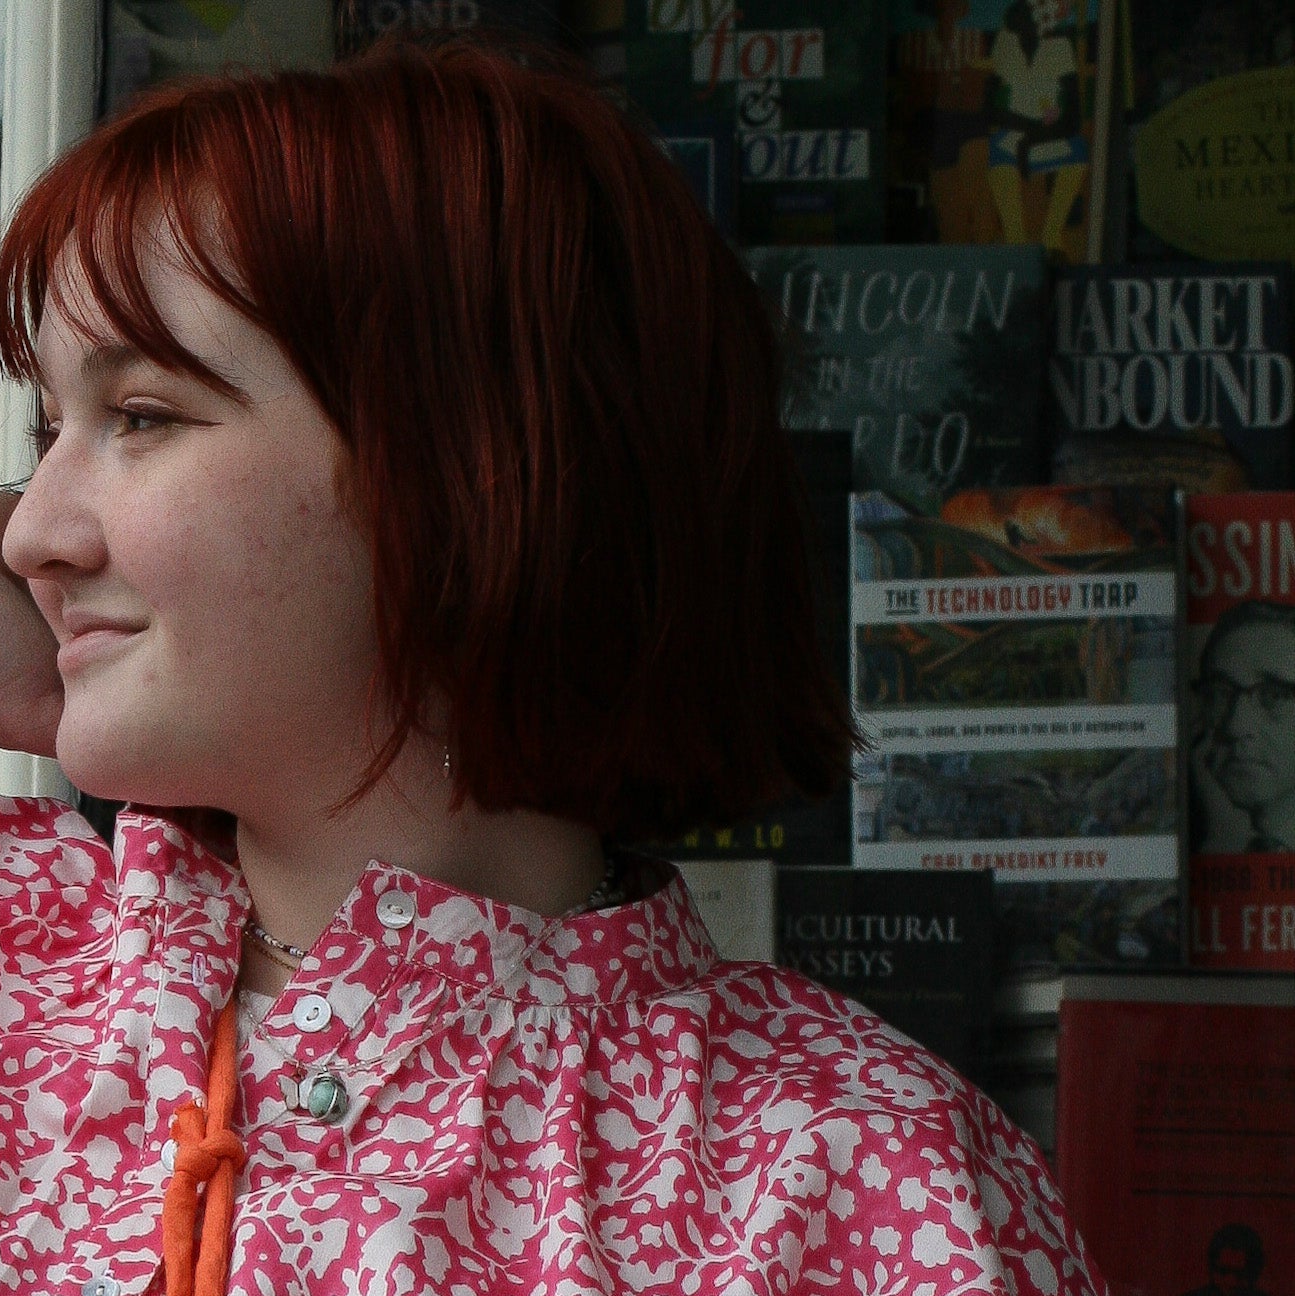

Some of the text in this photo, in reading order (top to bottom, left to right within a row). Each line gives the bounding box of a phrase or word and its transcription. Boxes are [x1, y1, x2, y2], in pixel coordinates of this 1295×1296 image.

[694, 11, 818, 101] for
[740, 80, 784, 126] &
[742, 128, 853, 178] out
[752, 270, 1016, 334] INCOLN
[885, 582, 1138, 613] THE TECHNOLOGY TRAP
[754, 823, 784, 849] LO
[921, 849, 1108, 869] CARL BENEDIKT FREY
